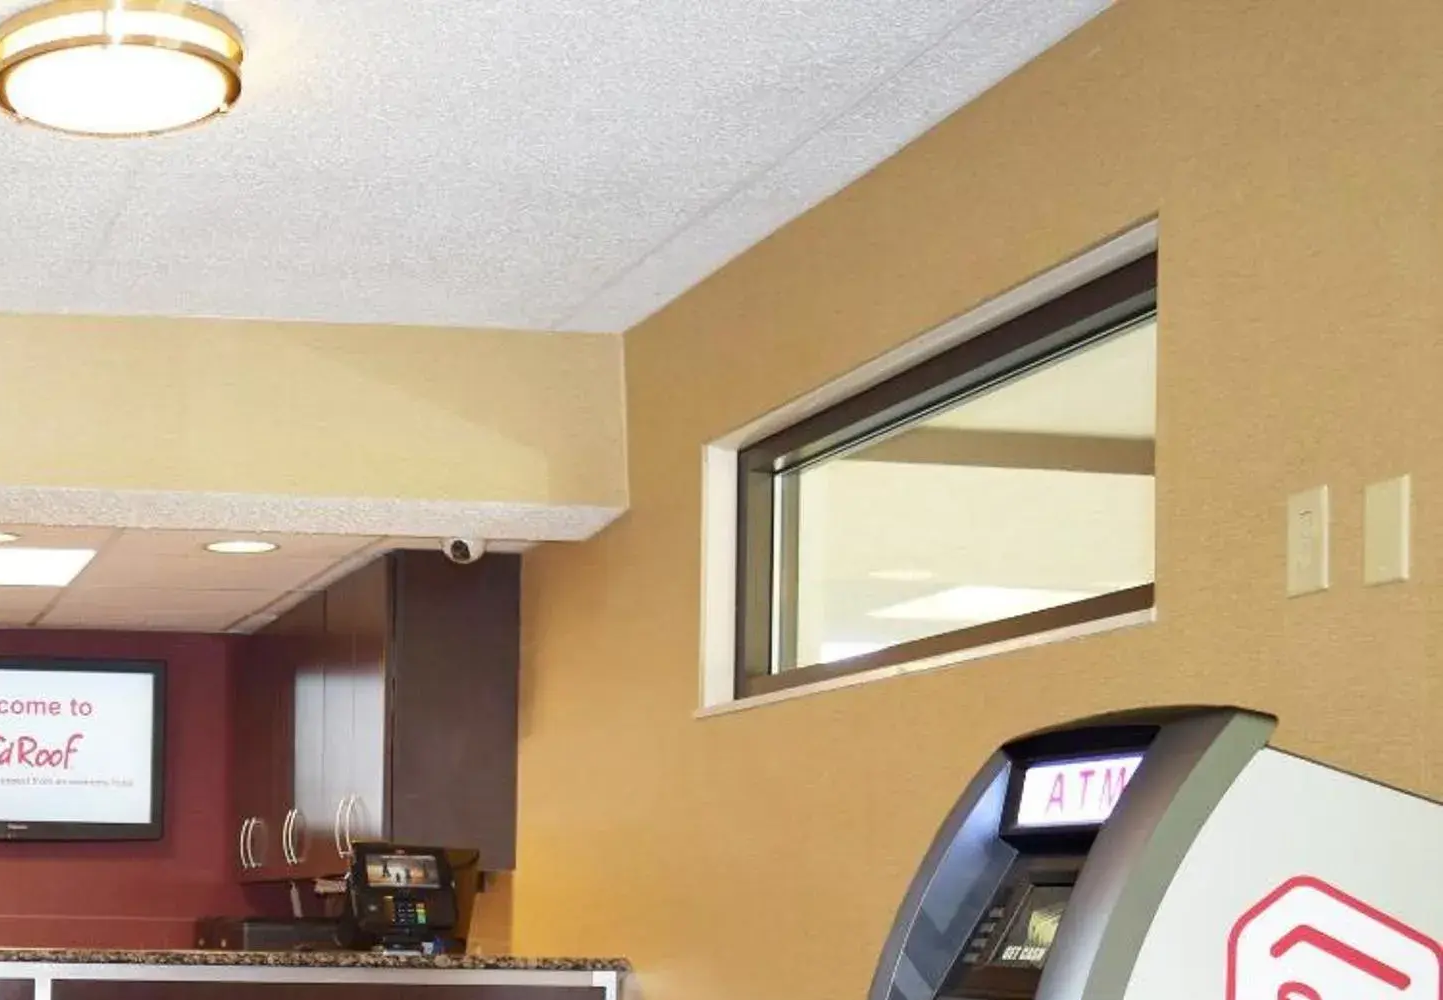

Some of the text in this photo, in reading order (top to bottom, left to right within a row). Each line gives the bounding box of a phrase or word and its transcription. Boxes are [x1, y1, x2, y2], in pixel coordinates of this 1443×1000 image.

[70, 698, 92, 716] to
[17, 733, 84, 769] Roof
[1045, 766, 1126, 815] ATM
